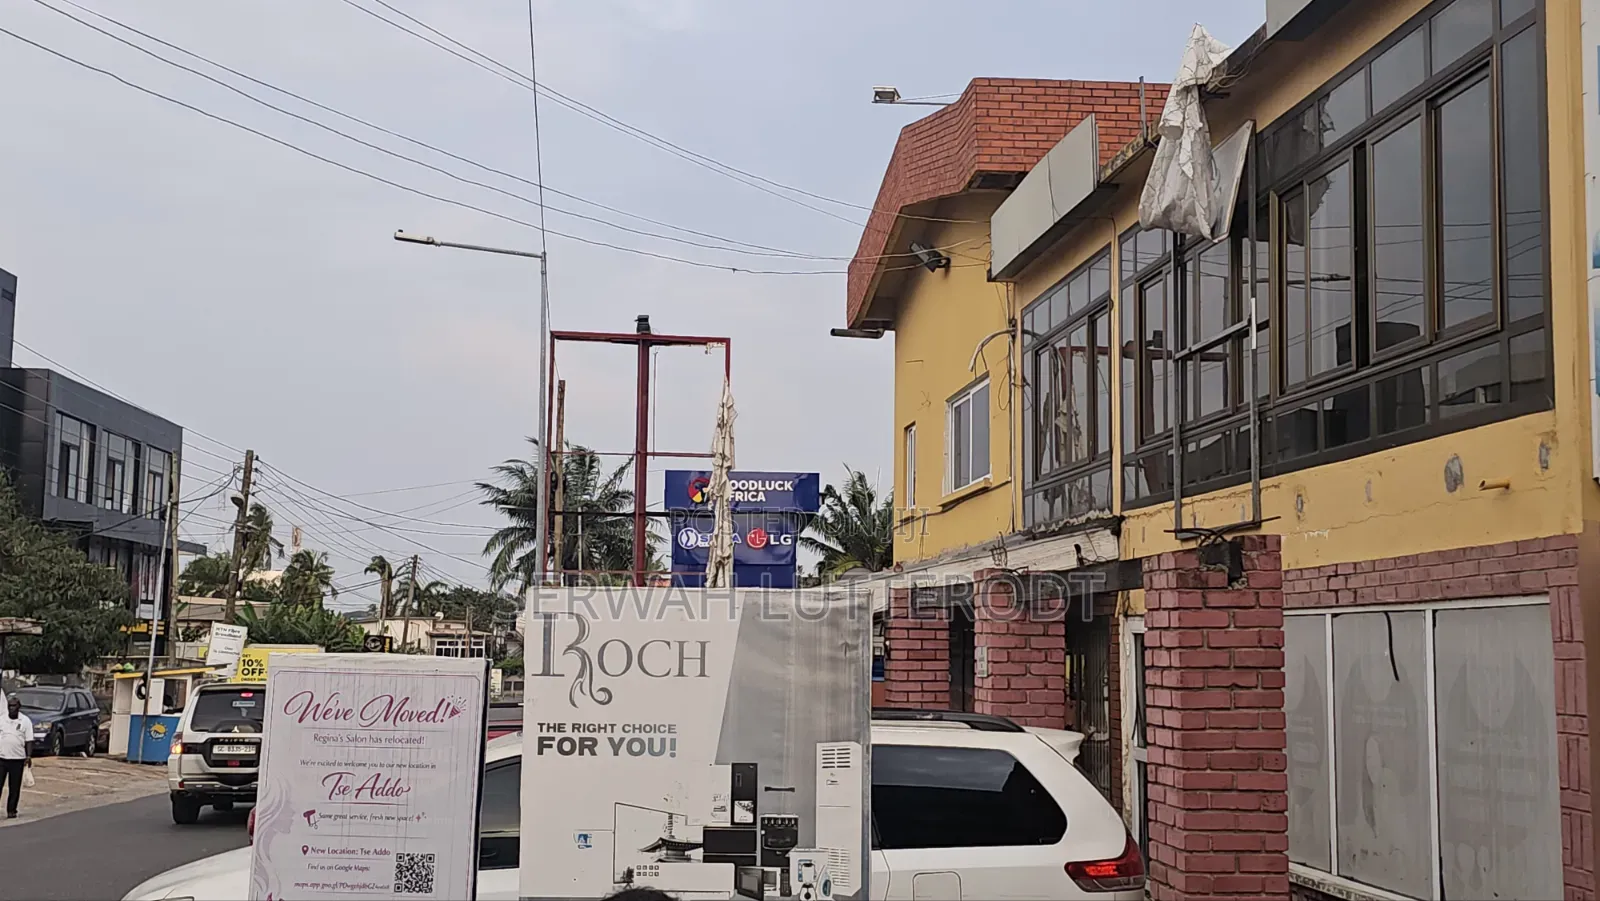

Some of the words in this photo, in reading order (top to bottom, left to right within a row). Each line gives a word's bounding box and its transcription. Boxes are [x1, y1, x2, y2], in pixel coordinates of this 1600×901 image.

[729, 480, 793, 491] OODLUCK
[729, 492, 766, 501] FRICA
[769, 534, 792, 545] LG
[242, 659, 263, 667] 10%
[532, 611, 711, 709] ROCH
[241, 667, 265, 676] OFF
[284, 691, 354, 724] We've
[359, 694, 451, 728] Moved!
[537, 722, 567, 733] THE
[571, 722, 617, 734] RIGHT
[621, 723, 677, 734] CHOICE
[313, 734, 344, 745] Regina's
[345, 735, 367, 743] Salon
[369, 735, 383, 743] has
[385, 736, 425, 745] relocated!
[537, 736, 599, 756] FOR
[606, 737, 677, 758] YOU!
[321, 771, 356, 800] Tse
[354, 772, 411, 800] Addo
[311, 847, 326, 855] New
[327, 847, 359, 855] Location:
[360, 848, 371, 856] Tse
[372, 848, 391, 856] Addo
[335, 864, 353, 872] Google
